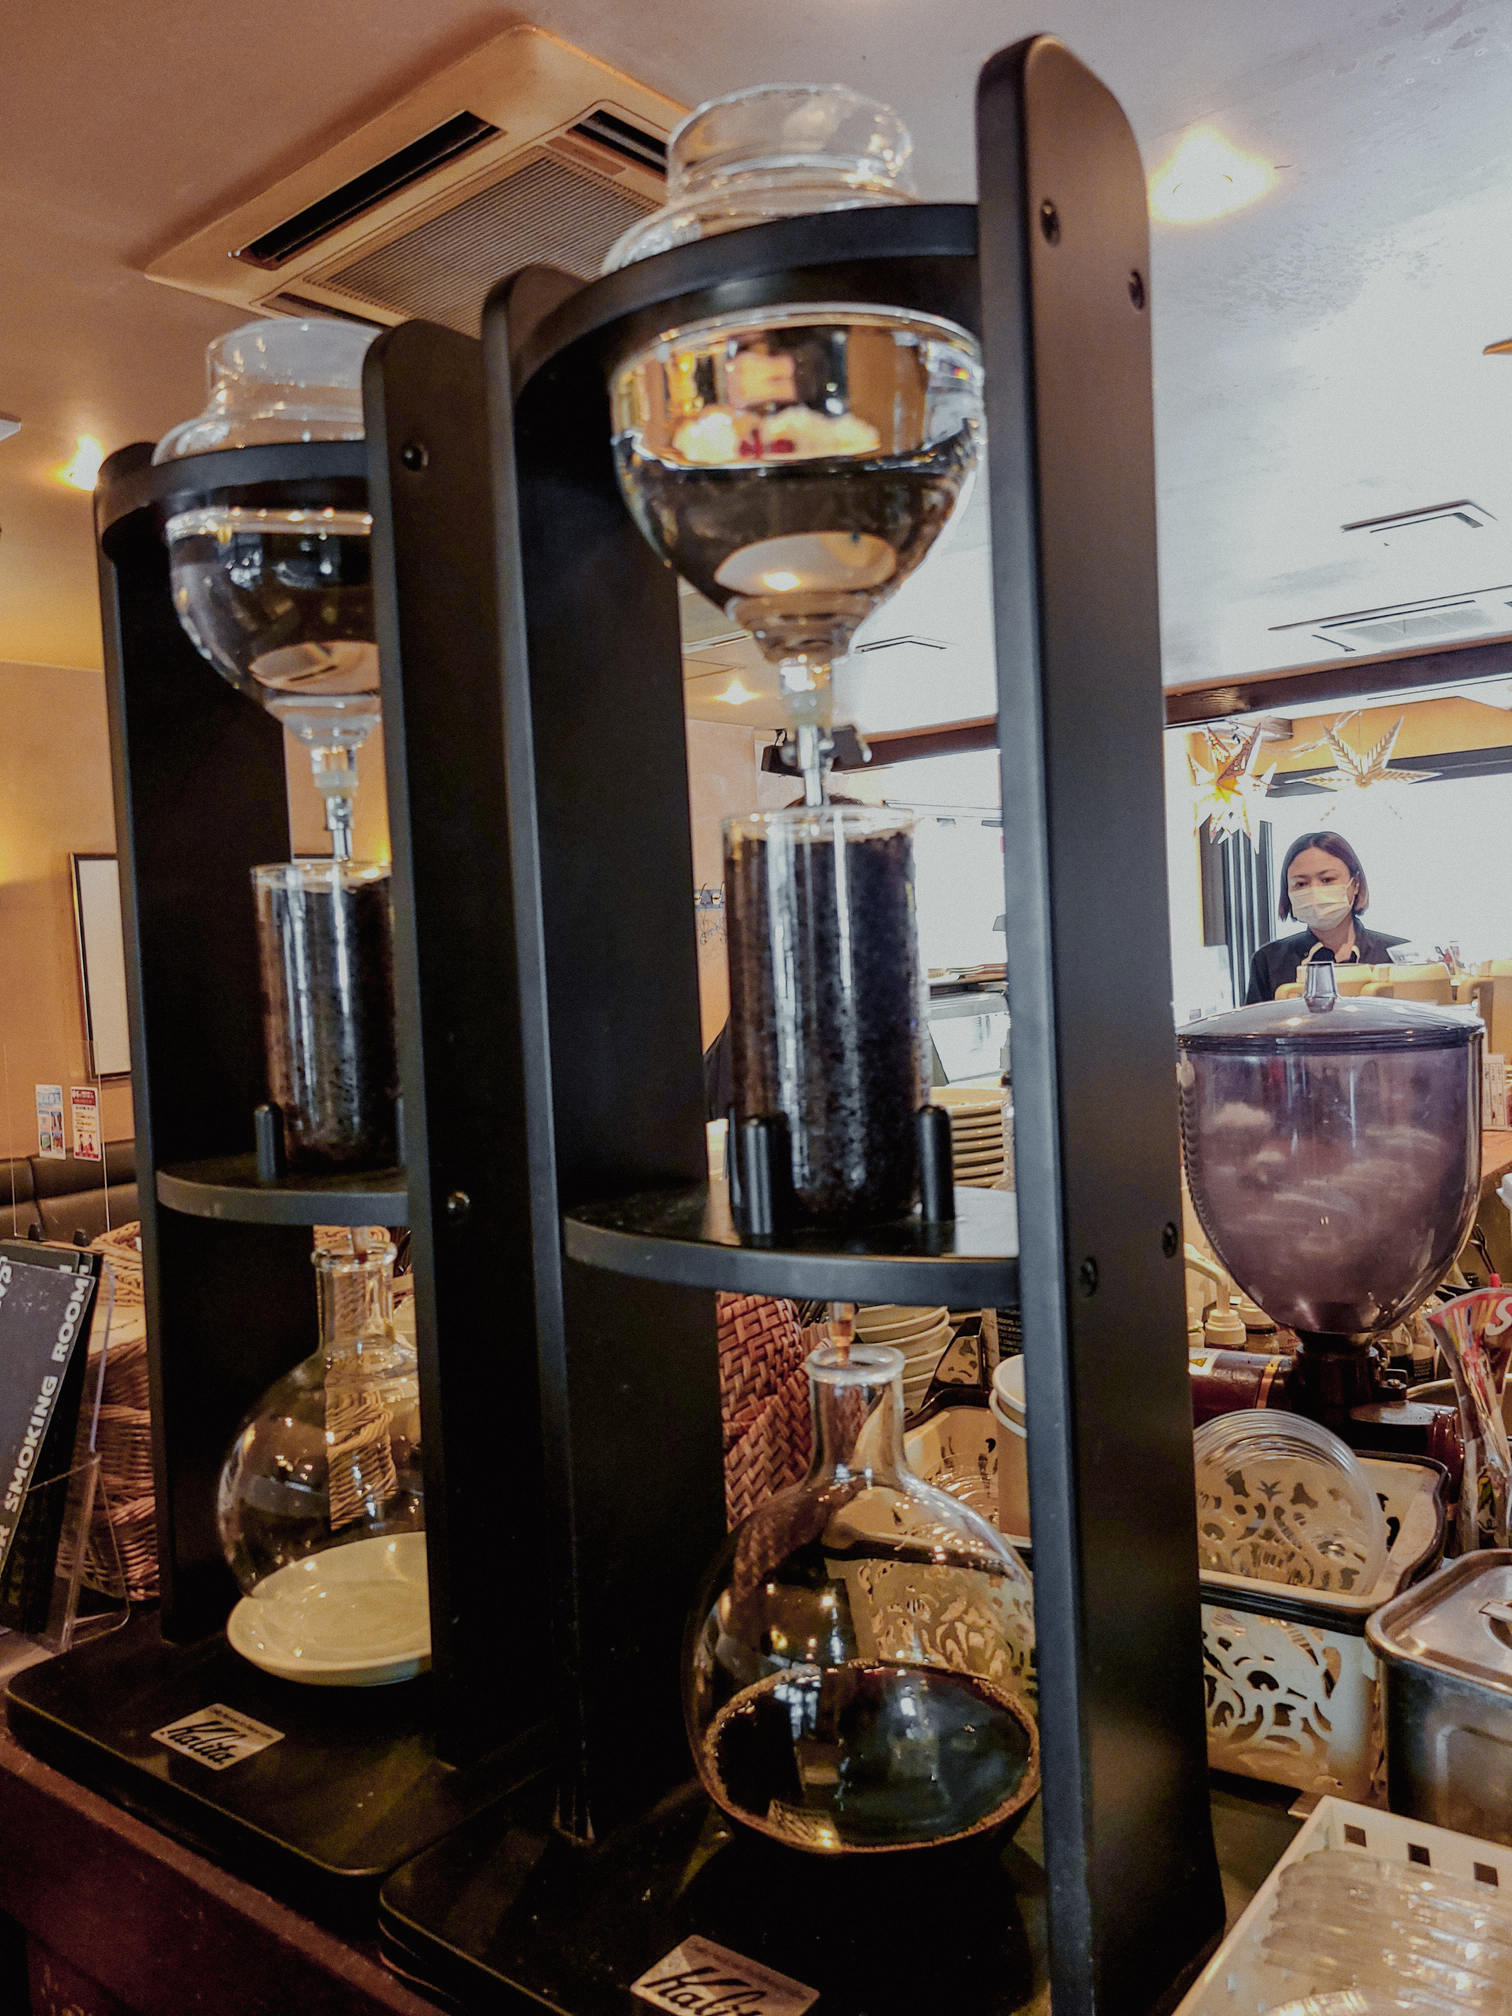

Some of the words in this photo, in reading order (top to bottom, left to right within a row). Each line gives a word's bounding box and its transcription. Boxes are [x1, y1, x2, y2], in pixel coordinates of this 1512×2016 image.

[4, 1375, 58, 1513] SMOKING
[51, 1277, 90, 1363] ROOM
[167, 1720, 247, 1765] Kalita
